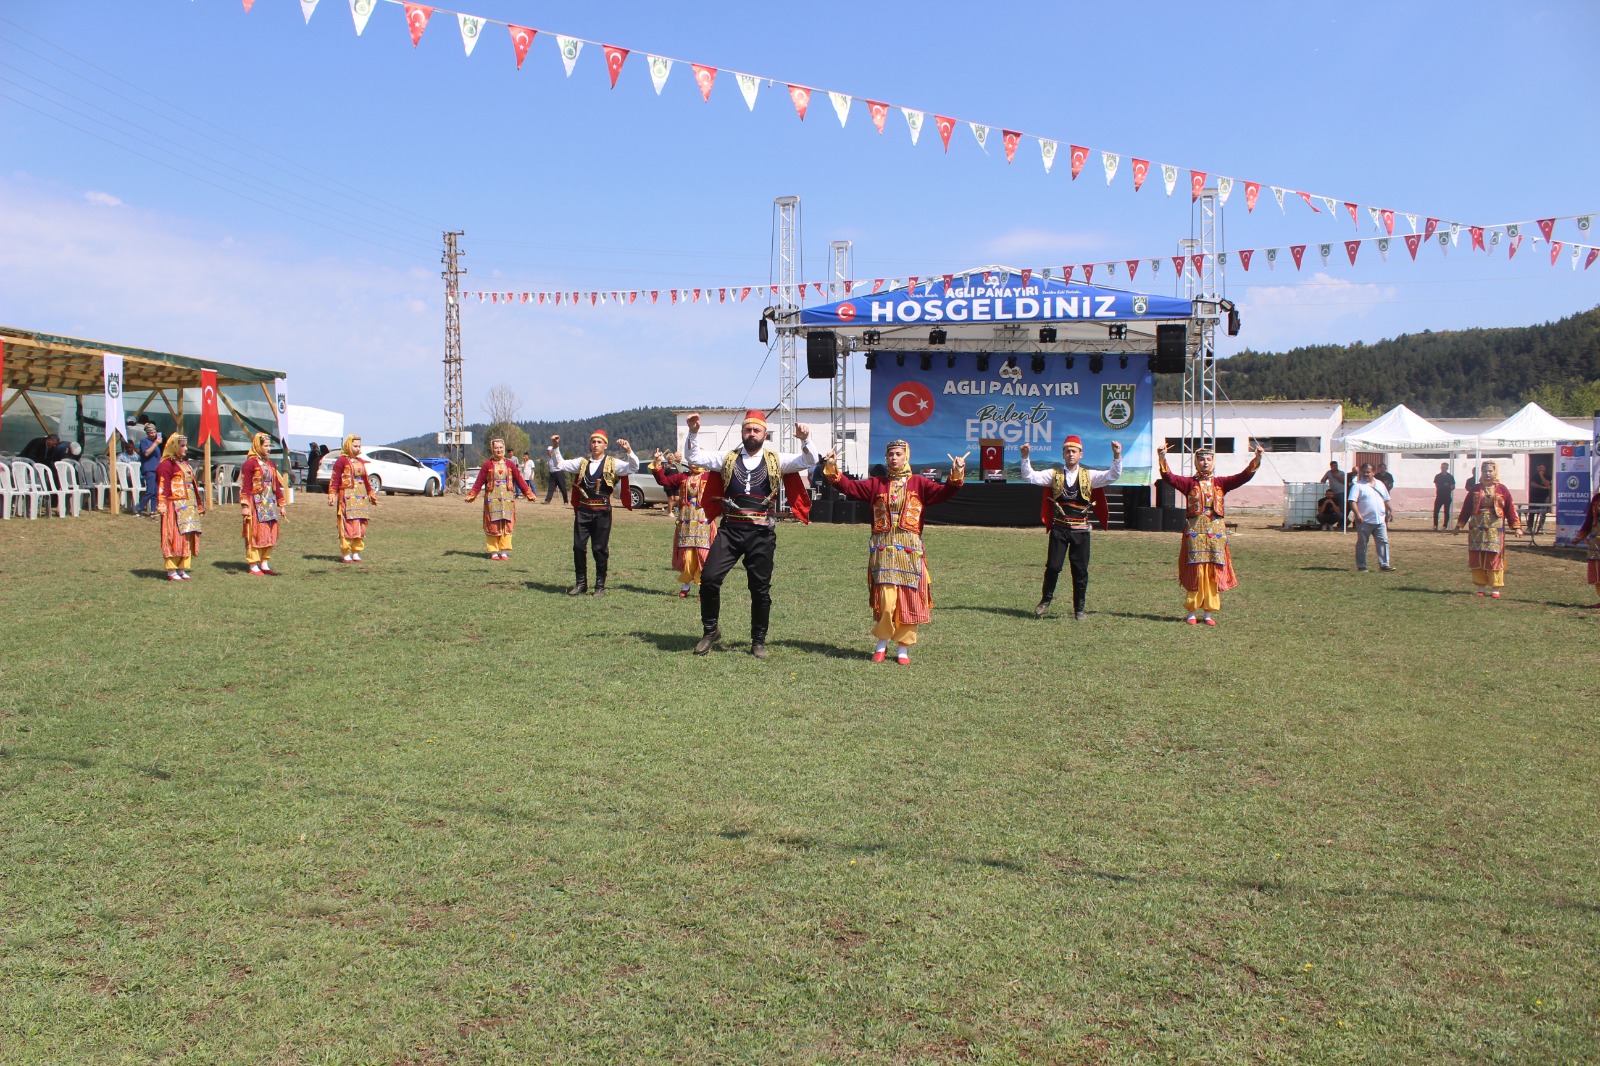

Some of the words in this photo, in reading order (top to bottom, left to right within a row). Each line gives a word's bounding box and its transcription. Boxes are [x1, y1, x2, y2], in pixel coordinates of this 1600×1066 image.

[989, 381, 1079, 397] PANAYIRI
[976, 401, 1054, 424] Bülent
[966, 419, 1052, 443] ERGİN
